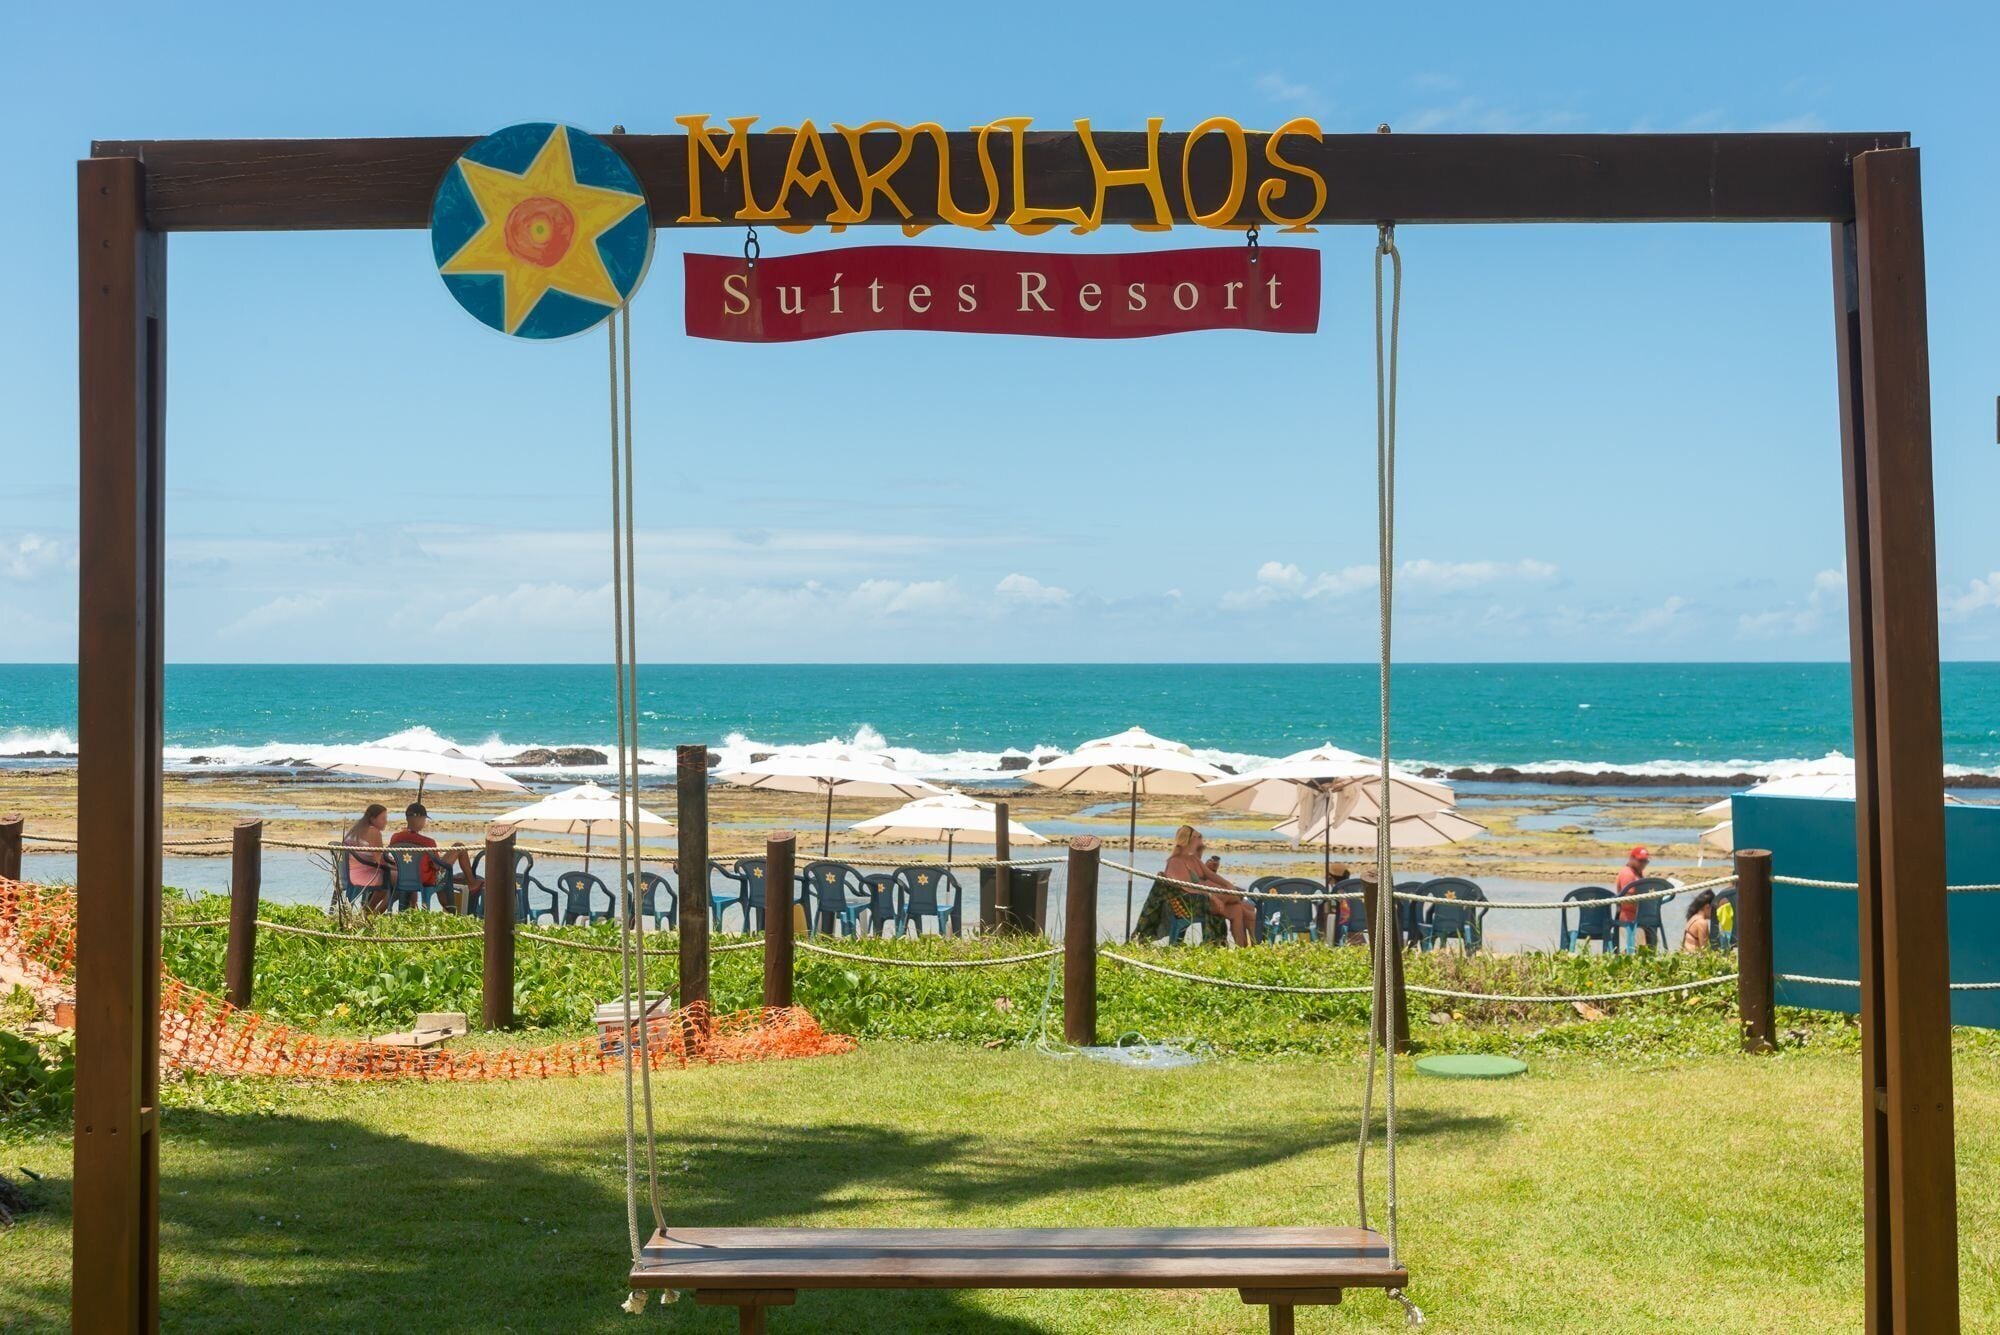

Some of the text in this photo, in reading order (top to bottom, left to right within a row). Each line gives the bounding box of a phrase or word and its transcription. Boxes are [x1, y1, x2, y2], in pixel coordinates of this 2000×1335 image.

[675, 114, 1328, 231] MARULHOS
[722, 271, 1283, 316] Suítes Resort
